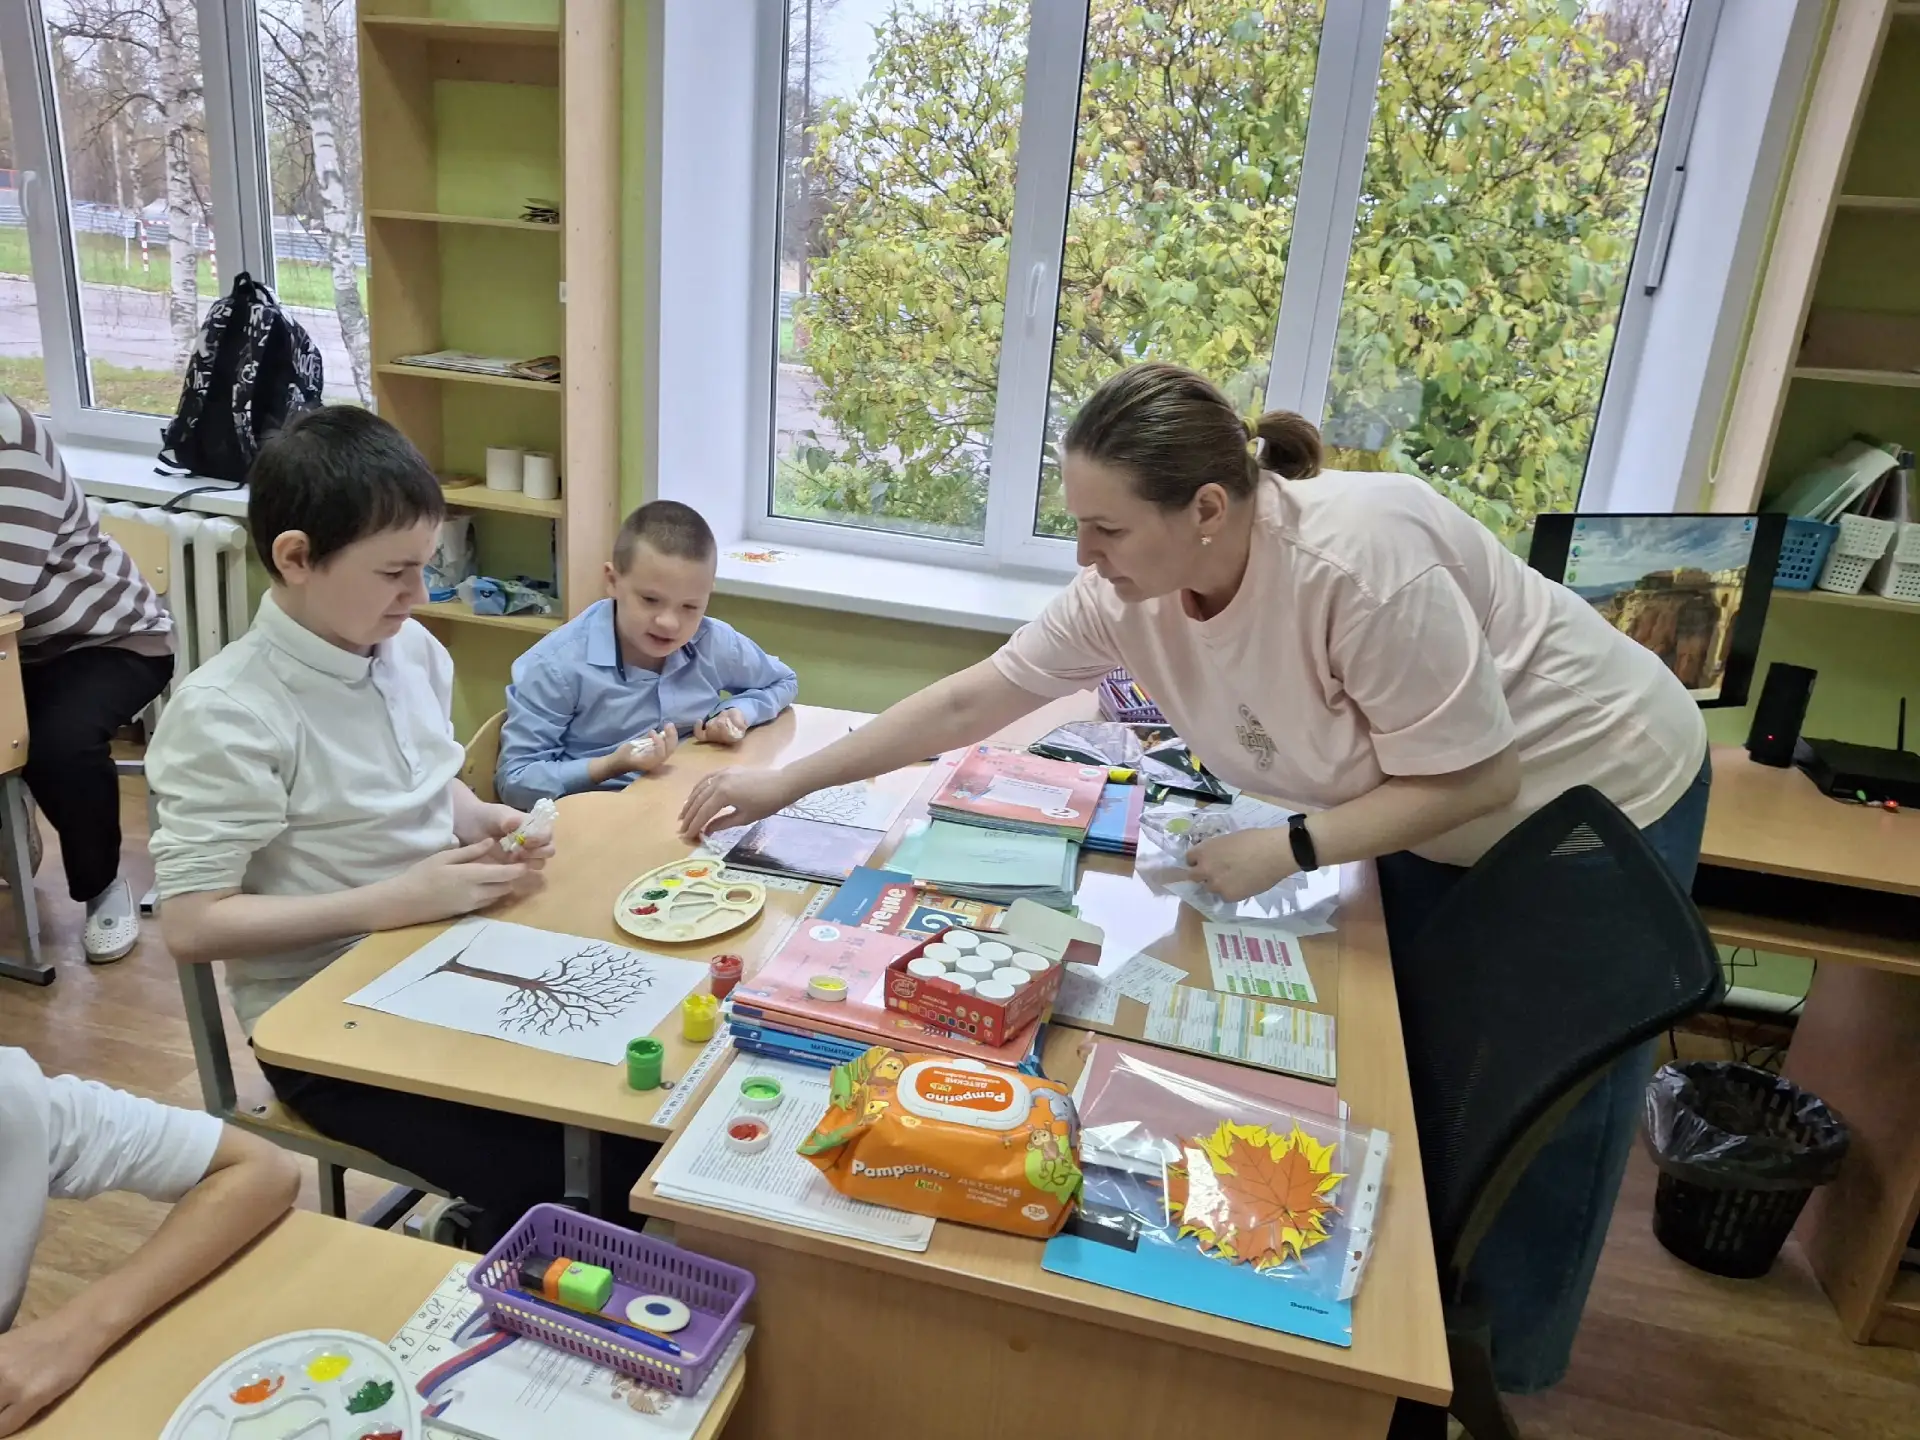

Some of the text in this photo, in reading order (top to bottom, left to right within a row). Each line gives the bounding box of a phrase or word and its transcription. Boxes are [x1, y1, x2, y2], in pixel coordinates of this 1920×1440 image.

[811, 1044, 855, 1057] МАТЕМАТИКА
[944, 1077, 988, 1089] ДЕТСКИЕ
[925, 1091, 1006, 1104] Pamperino
[851, 1159, 950, 1179] Pamperino
[915, 1179, 942, 1192] kids
[957, 1178, 1021, 1198] ДЕТСКИЕ
[1290, 1301, 1329, 1314] Berlingo
